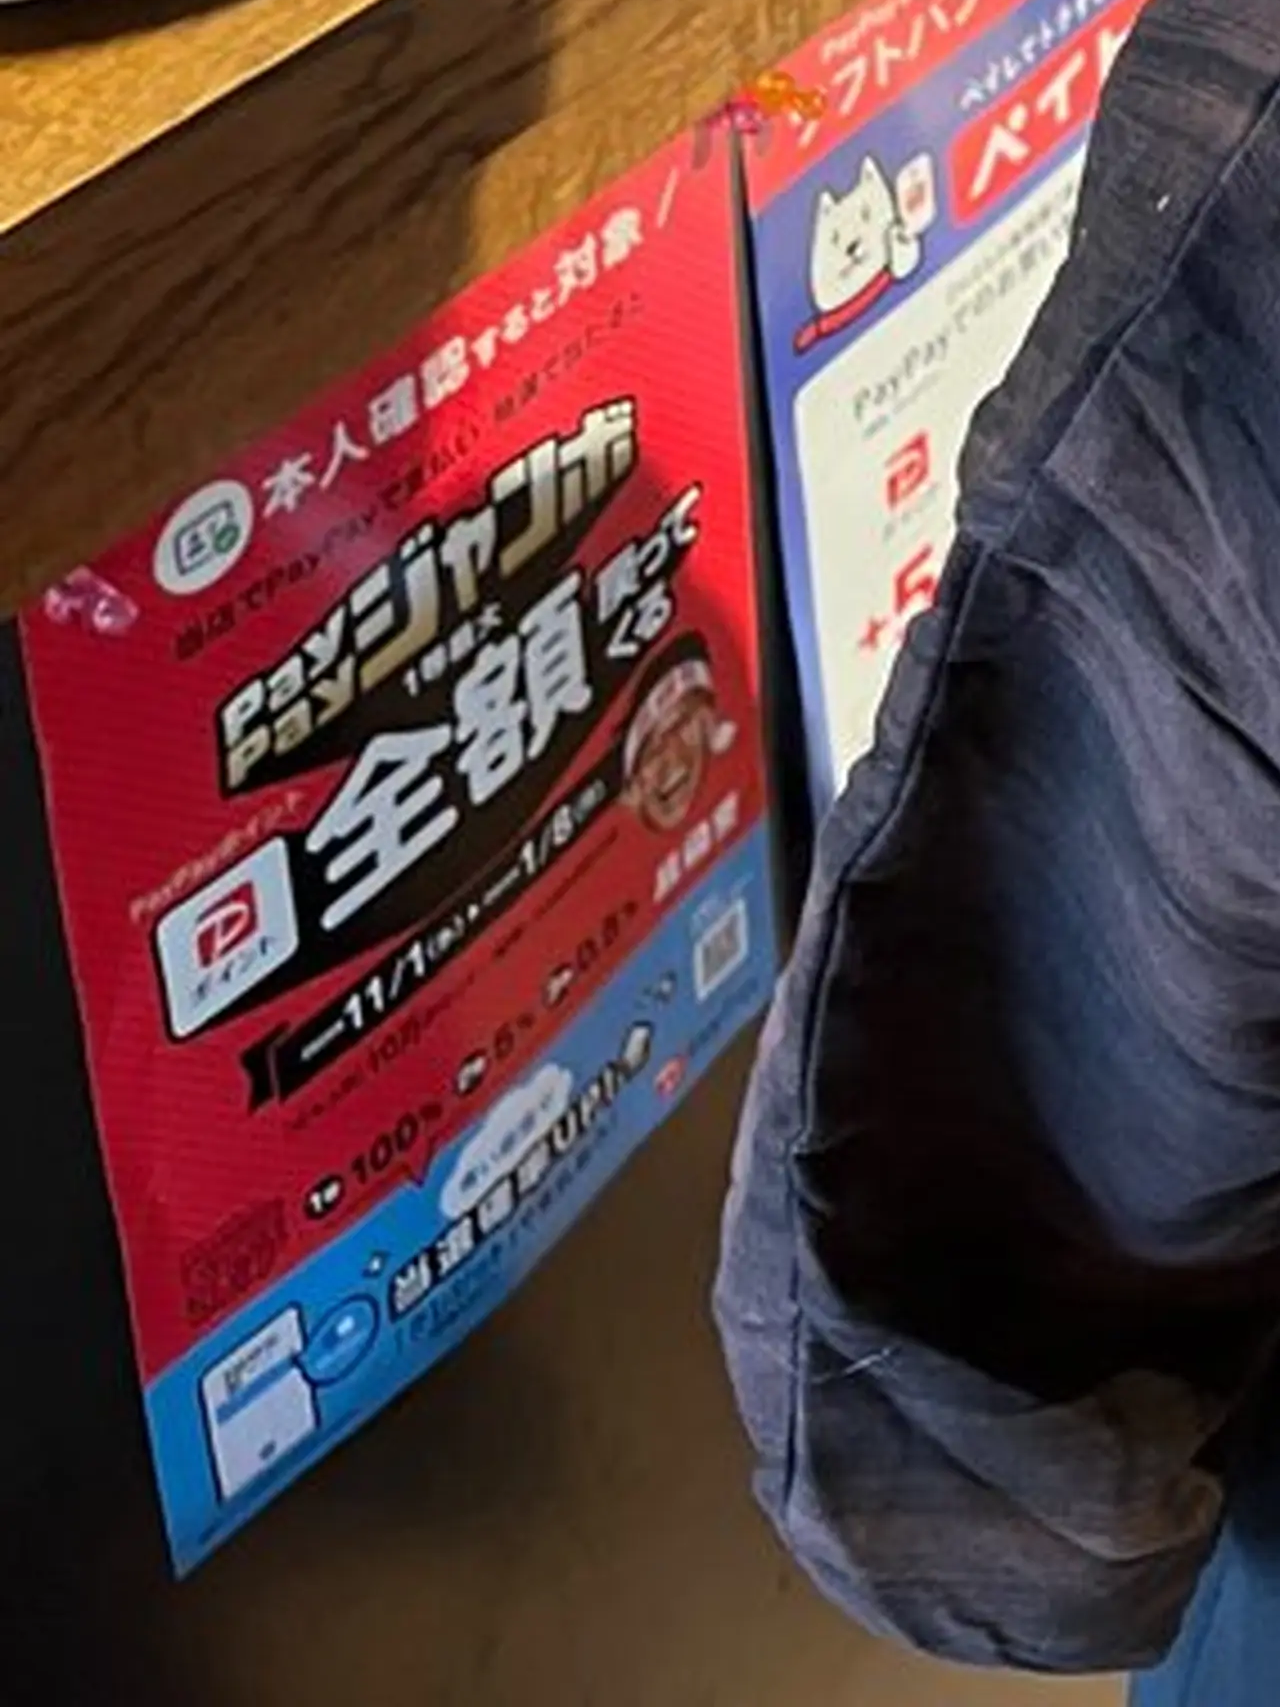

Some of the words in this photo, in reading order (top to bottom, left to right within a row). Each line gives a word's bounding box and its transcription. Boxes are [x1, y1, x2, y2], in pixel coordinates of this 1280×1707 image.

[262, 206, 644, 518] 本人確認すると対象
[350, 401, 634, 688] ジャンボ
[305, 572, 592, 931] 全額
